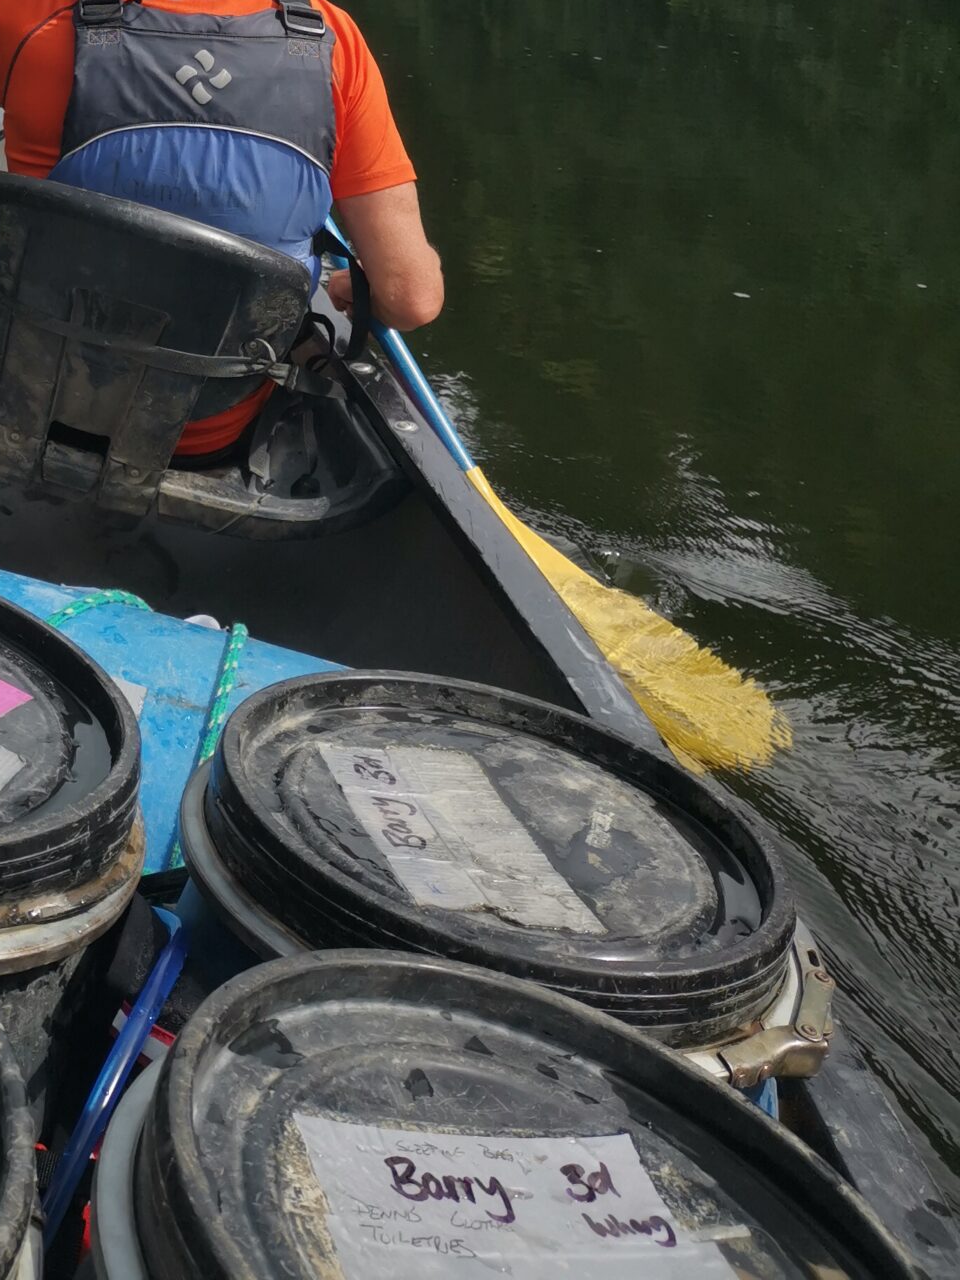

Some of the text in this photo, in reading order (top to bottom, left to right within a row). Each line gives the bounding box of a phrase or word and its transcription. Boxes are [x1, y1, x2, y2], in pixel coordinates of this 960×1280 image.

[353, 754, 427, 850] Barry 3d
[384, 1156, 621, 1224] Barry 3d
